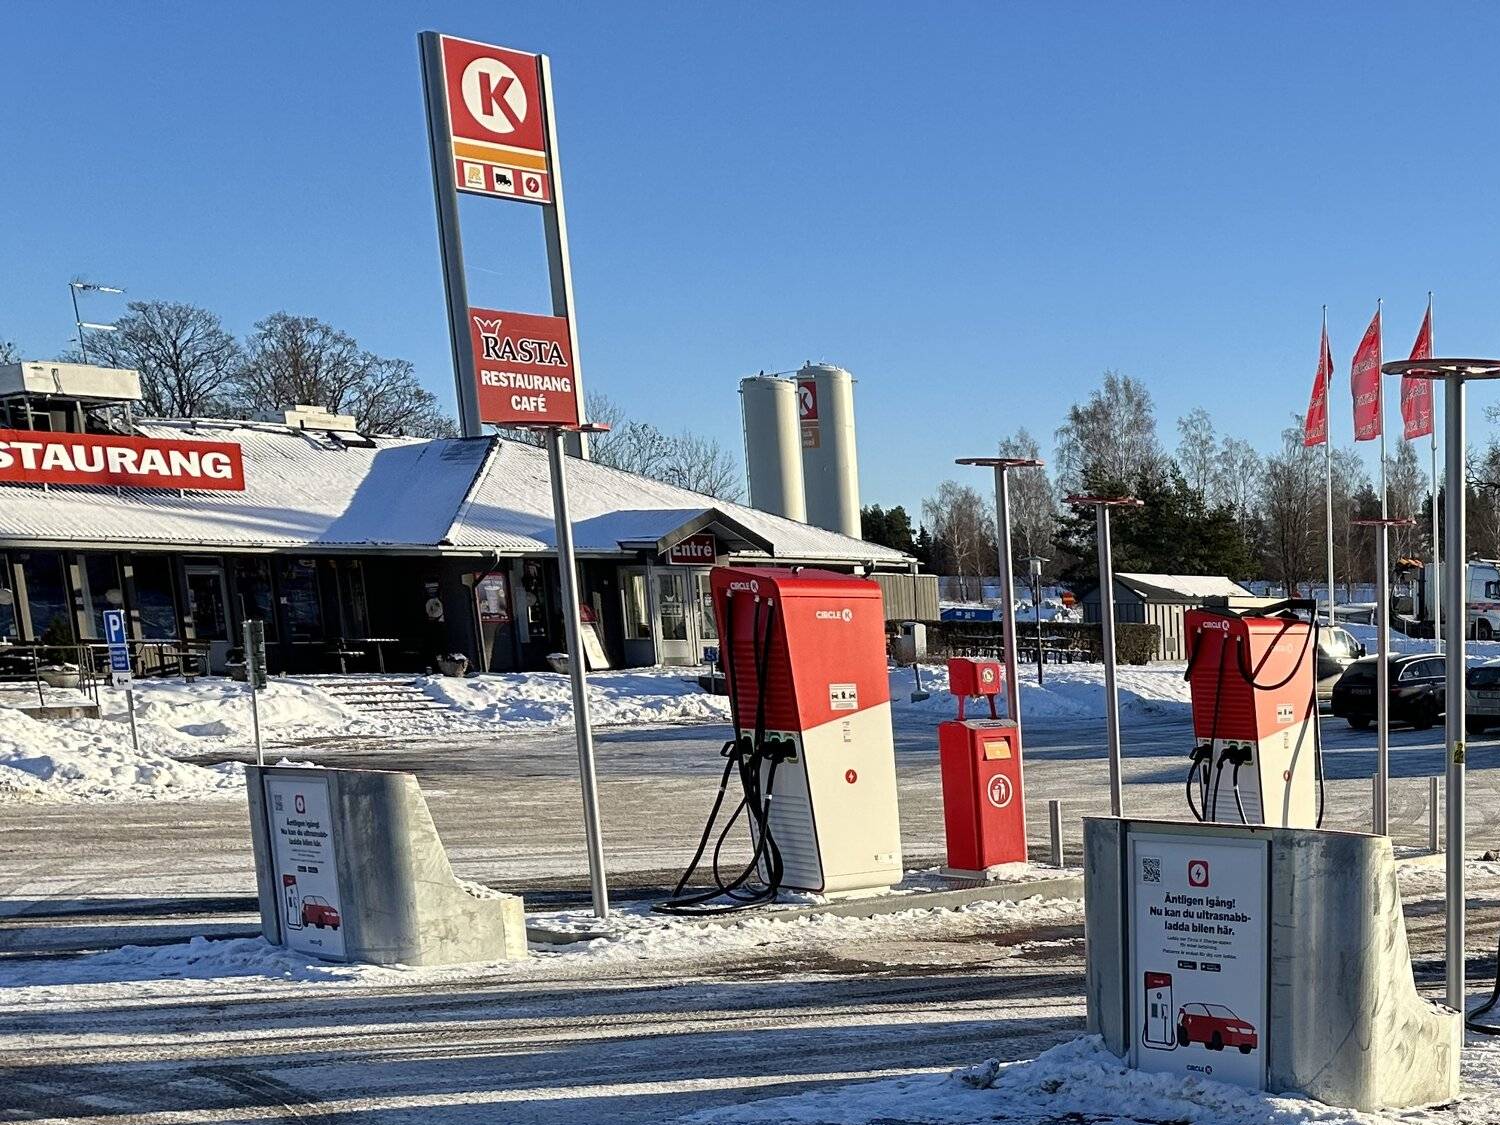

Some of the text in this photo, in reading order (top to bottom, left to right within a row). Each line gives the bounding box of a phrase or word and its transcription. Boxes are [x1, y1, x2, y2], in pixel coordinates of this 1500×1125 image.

[482, 336, 567, 367] RASTA
[481, 370, 571, 392] RESTAURANG
[510, 394, 548, 412] CAFÉ
[730, 582, 750, 591] CIRCLE
[815, 610, 841, 619] CIRCLE
[109, 614, 120, 641] P
[1164, 892, 1204, 906] Äntligen
[1149, 906, 1251, 922] Nu kan du ultrasnabb-
[1164, 921, 1235, 935] ladda bilen här.
